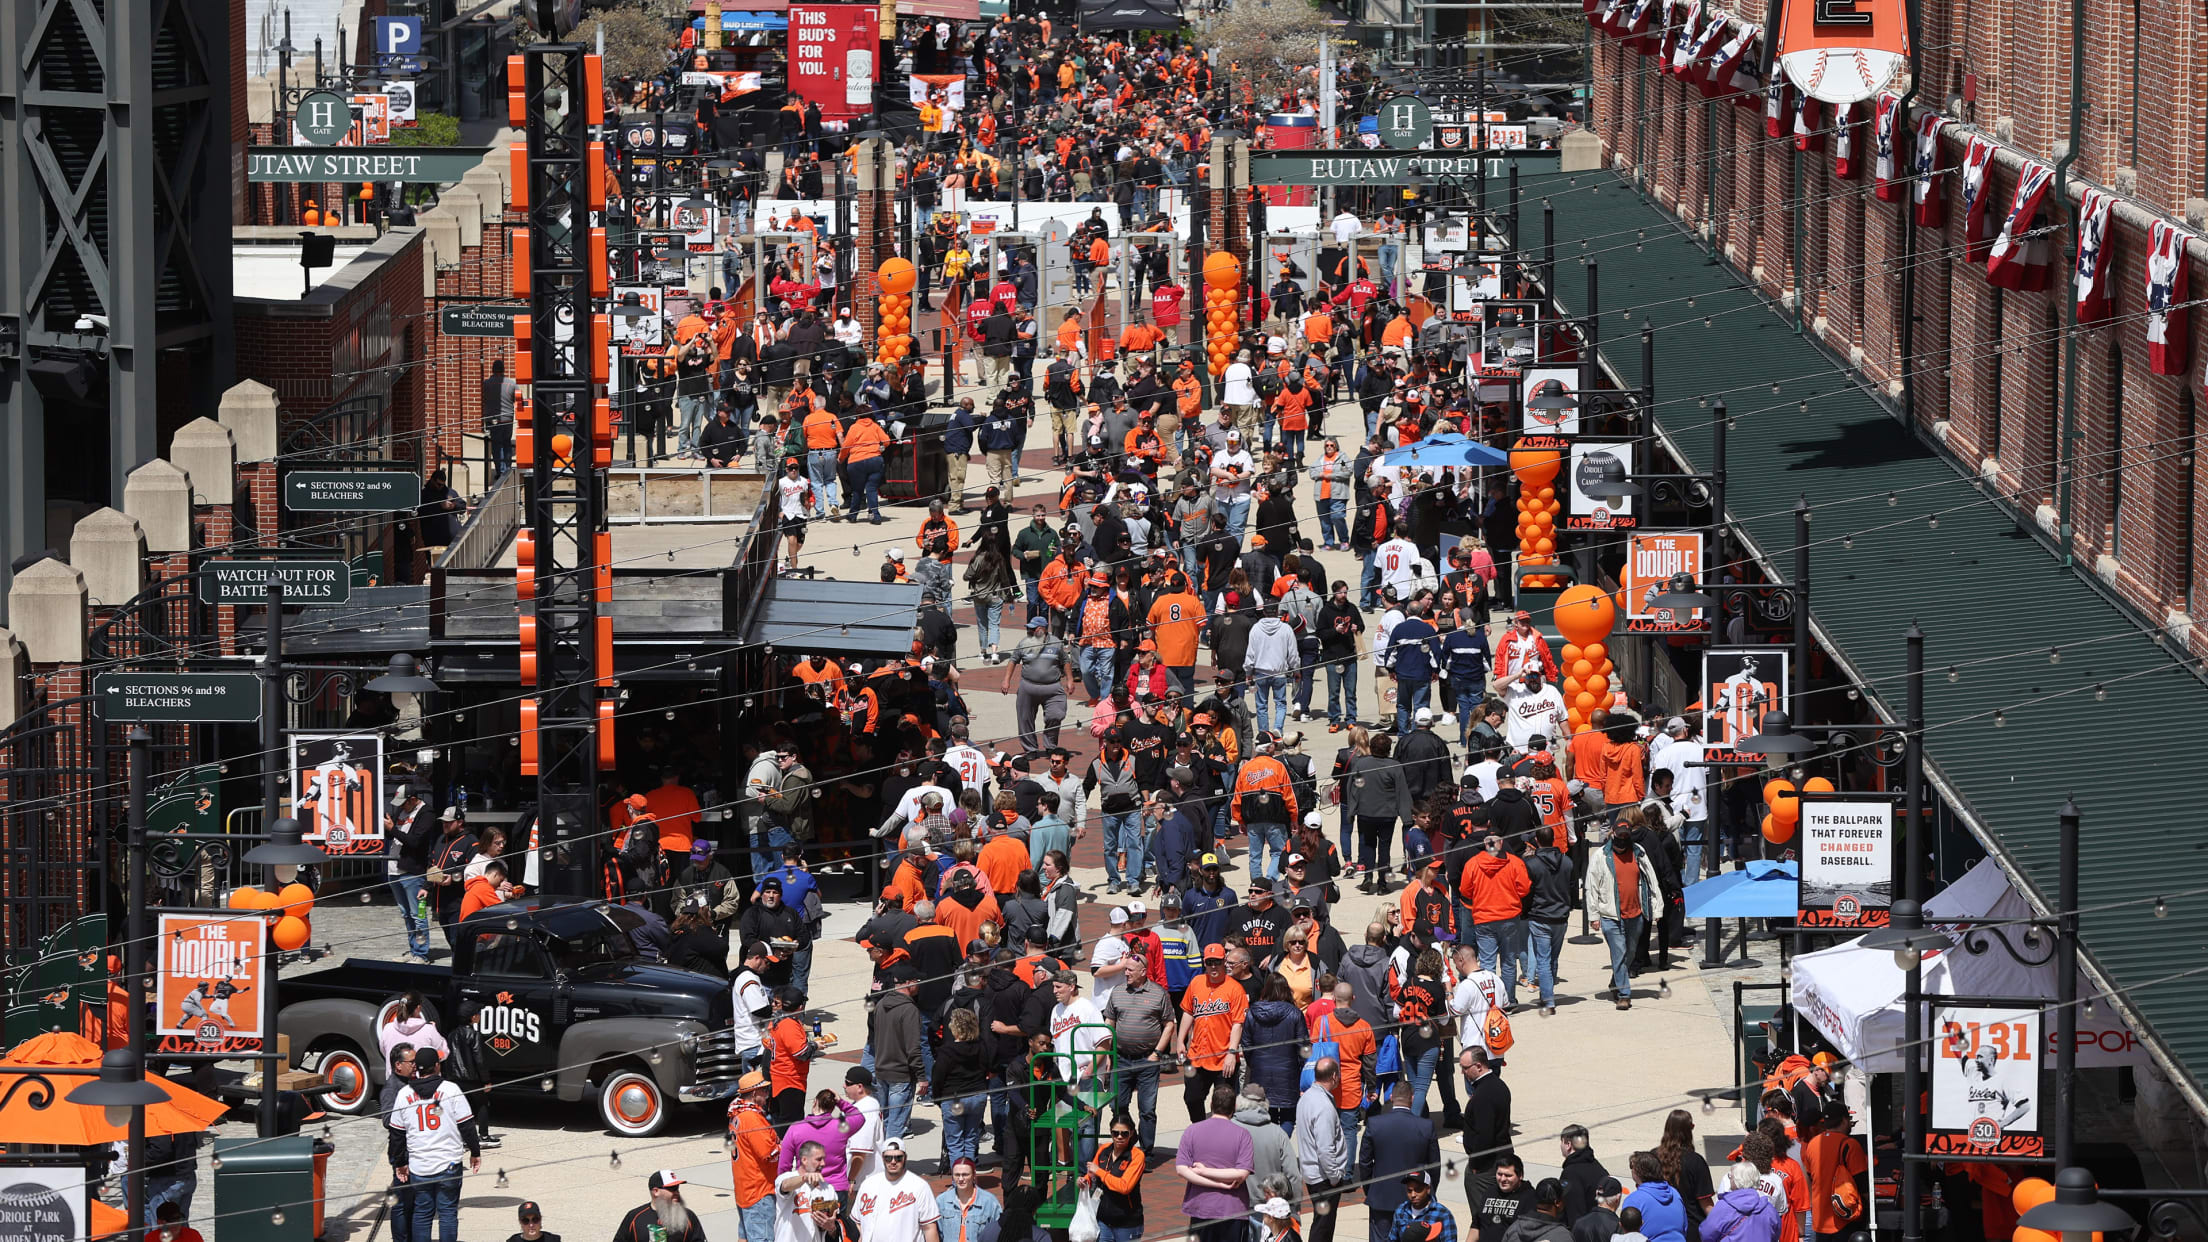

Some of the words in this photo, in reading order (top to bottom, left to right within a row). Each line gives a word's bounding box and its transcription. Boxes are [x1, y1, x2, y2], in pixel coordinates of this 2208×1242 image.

[798, 11, 826, 25] THIS
[723, 21, 740, 29] BUD
[741, 21, 765, 29] LIGHT
[388, 22, 411, 53] P
[798, 28, 836, 42] BUD'S
[798, 45, 823, 58] FOR
[798, 61, 827, 75] YOU.
[308, 102, 335, 128] H
[1390, 104, 1416, 131] H
[248, 155, 316, 175] UTAW
[324, 154, 421, 176] STREET
[1310, 158, 1400, 178] EUTAW
[461, 312, 497, 320] SECTIONS
[497, 313, 506, 321] 90
[461, 320, 504, 328] BLEACHERS
[310, 482, 354, 490] SECTIONS
[355, 482, 365, 490] 92
[367, 482, 380, 490] and
[382, 482, 392, 490] 96
[1582, 478, 1602, 486] CAMD
[311, 491, 364, 500] BLEACHERS
[1654, 539, 1676, 550] THE
[1386, 554, 1400, 571] 10
[1636, 550, 1693, 578] DOUBLE
[217, 569, 268, 581] WATCH
[306, 569, 336, 581] FOR
[220, 585, 268, 597] BATTE
[283, 585, 331, 597] BALLS
[1169, 603, 1182, 621] 8
[1658, 610, 1670, 620] 30
[125, 685, 179, 695] SECTIONS
[181, 686, 193, 695] 96
[195, 686, 212, 695] and
[214, 686, 226, 695] 98
[125, 698, 191, 707] BLEACHERS
[1519, 699, 1555, 717] Orioles
[961, 761, 977, 782] 21
[1811, 816, 1830, 824] THE
[1833, 816, 1883, 824] BALLPARK
[331, 830, 345, 841] 30
[1811, 829, 1836, 838] THAT
[1839, 829, 1883, 838] FOREVER
[1820, 843, 1873, 852] CHANGED
[1820, 856, 1873, 865] BASEBALL.
[1840, 901, 1854, 912] 30
[1242, 918, 1275, 932] ORIOLES
[198, 925, 228, 939] THE
[1245, 936, 1274, 946] ASEBALL
[171, 940, 253, 980] DOUBLE
[1193, 997, 1231, 1017] Orioles
[473, 1005, 540, 1043] OOG'S
[202, 1026, 217, 1037] 30
[494, 1038, 511, 1049] BBQ
[1942, 1021, 2031, 1061] 2131
[416, 1104, 440, 1131] 16
[1977, 1124, 1993, 1137] 30
[1485, 1197, 1520, 1209] BOSTON
[35, 1210, 60, 1223] PARK
[0, 1234, 31, 1242] AMDEN
